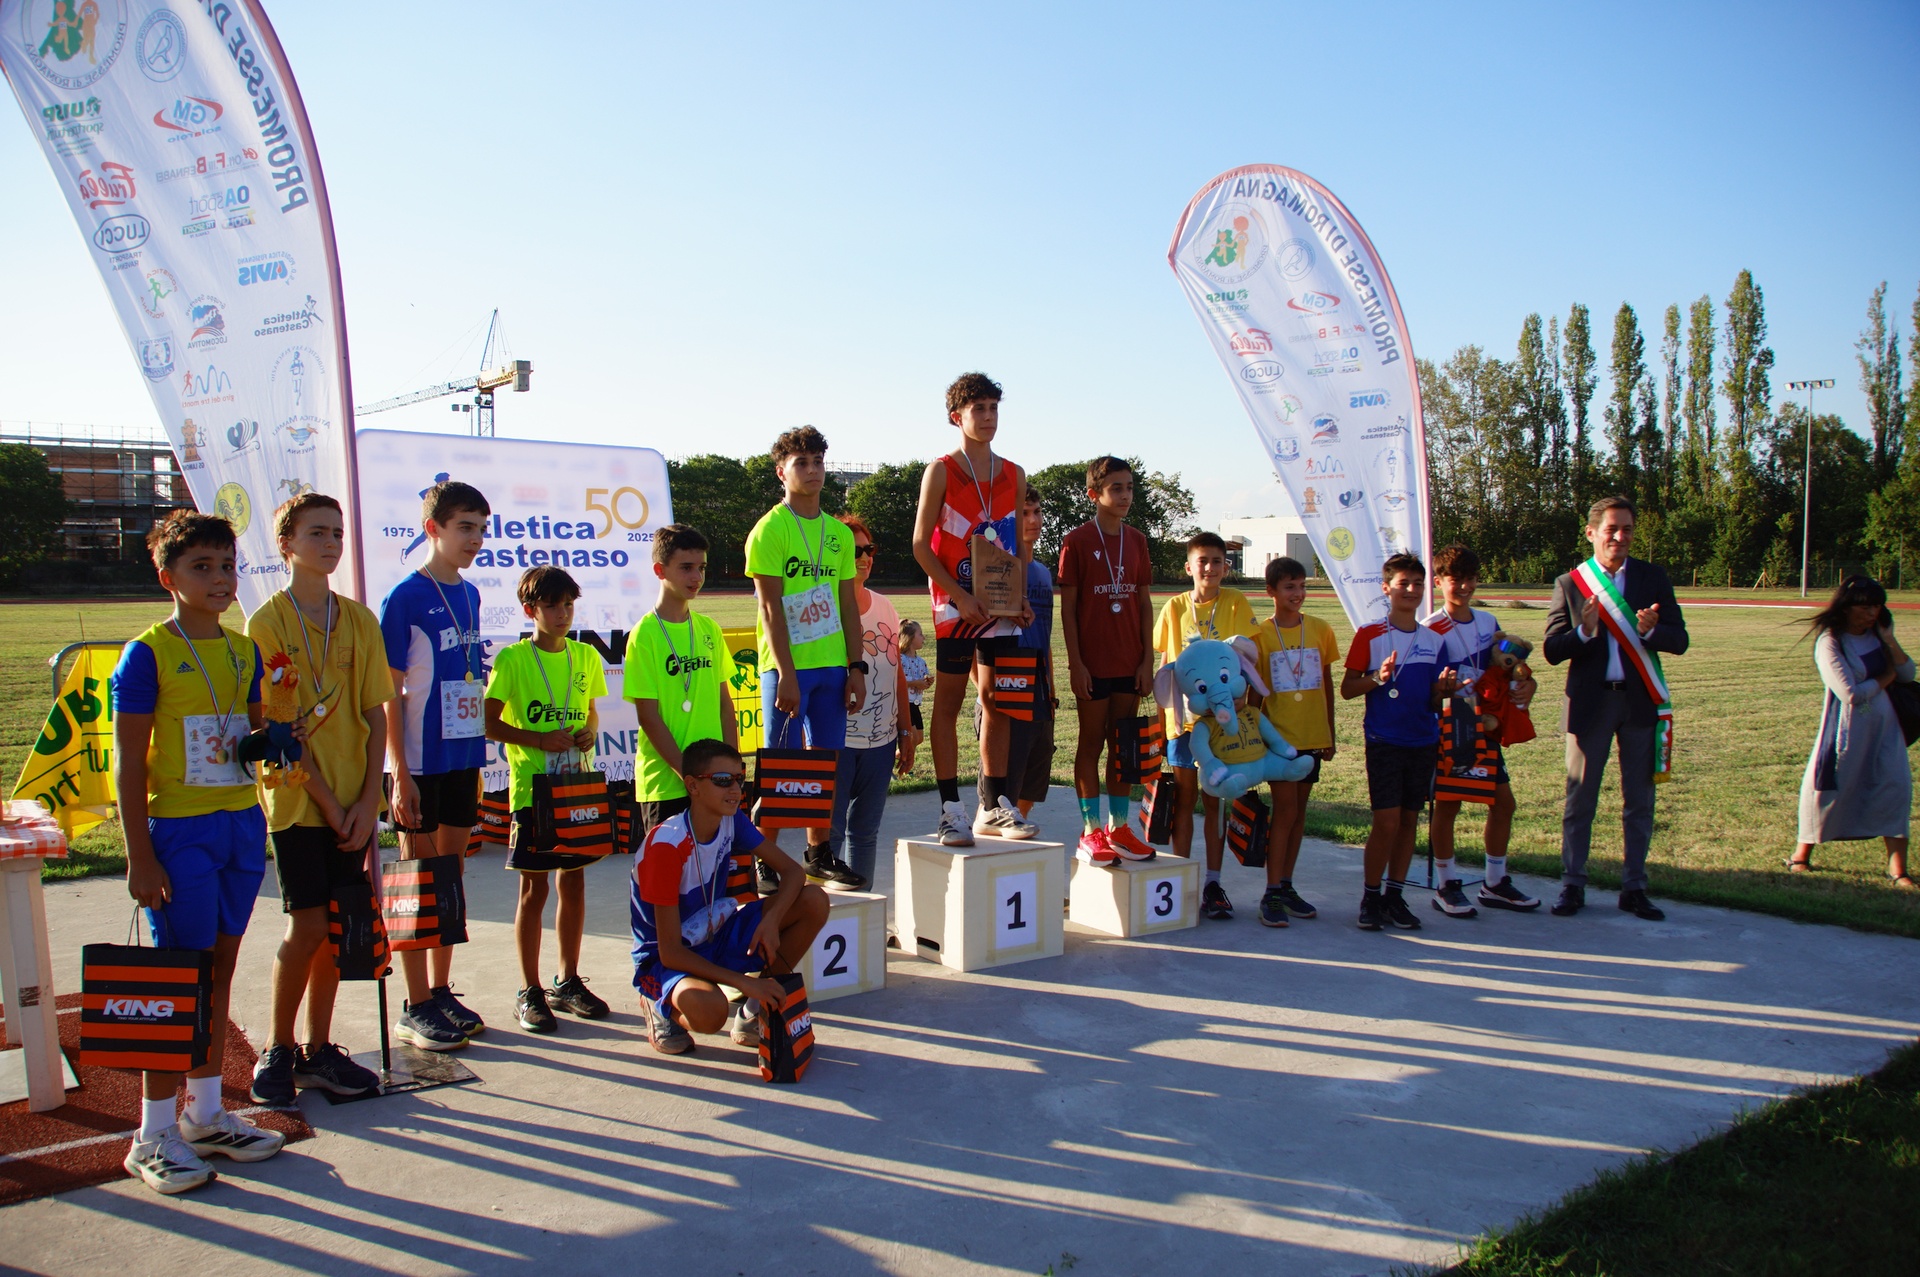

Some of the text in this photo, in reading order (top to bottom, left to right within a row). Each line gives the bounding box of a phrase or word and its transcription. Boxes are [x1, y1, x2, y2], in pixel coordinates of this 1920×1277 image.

[585, 486, 650, 539] 50
[382, 526, 654, 543] 1975 2025
[483, 514, 596, 540] tletica
[476, 543, 629, 568] astenaso
[799, 600, 831, 626] 499
[995, 677, 1028, 689] KING
[205, 734, 239, 765] 31
[775, 781, 823, 794] KING
[484, 813, 503, 825] KING
[570, 806, 600, 822] KING
[391, 898, 420, 913] KING
[1006, 890, 1027, 931] 1
[1153, 880, 1174, 917] 3
[823, 933, 849, 978] 2
[102, 998, 175, 1018] KING
[788, 1011, 812, 1037] KING
